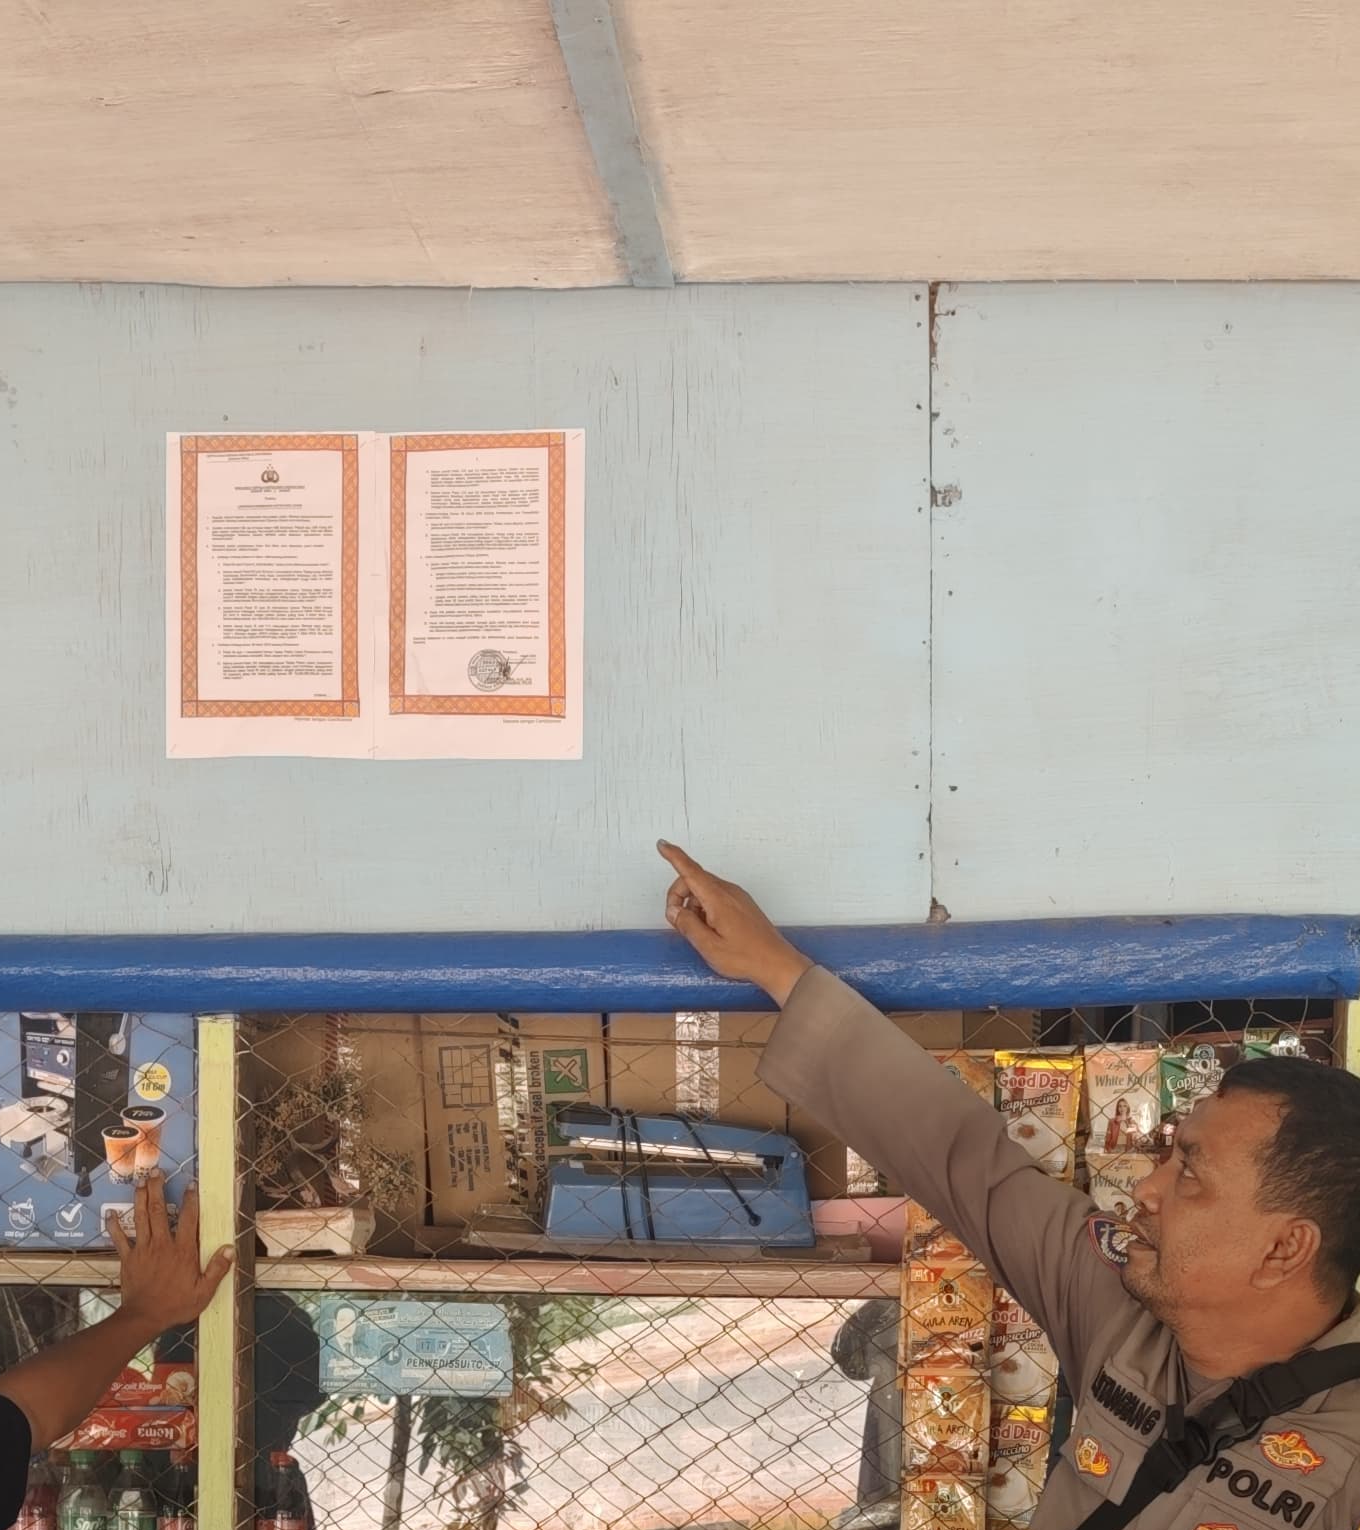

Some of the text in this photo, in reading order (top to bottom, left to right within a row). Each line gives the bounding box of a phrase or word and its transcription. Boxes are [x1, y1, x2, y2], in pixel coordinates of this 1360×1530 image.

[528, 1050, 540, 1088] broken
[1187, 1059, 1220, 1073] TOP
[996, 1072, 1071, 1093] Good Day
[1095, 1075, 1124, 1088] White
[1094, 1175, 1124, 1188] White
[923, 1316, 973, 1328] GULA AREN
[993, 1310, 1018, 1324] ood
[1013, 1428, 1041, 1443] Day
[1206, 1457, 1315, 1529] POLRI
